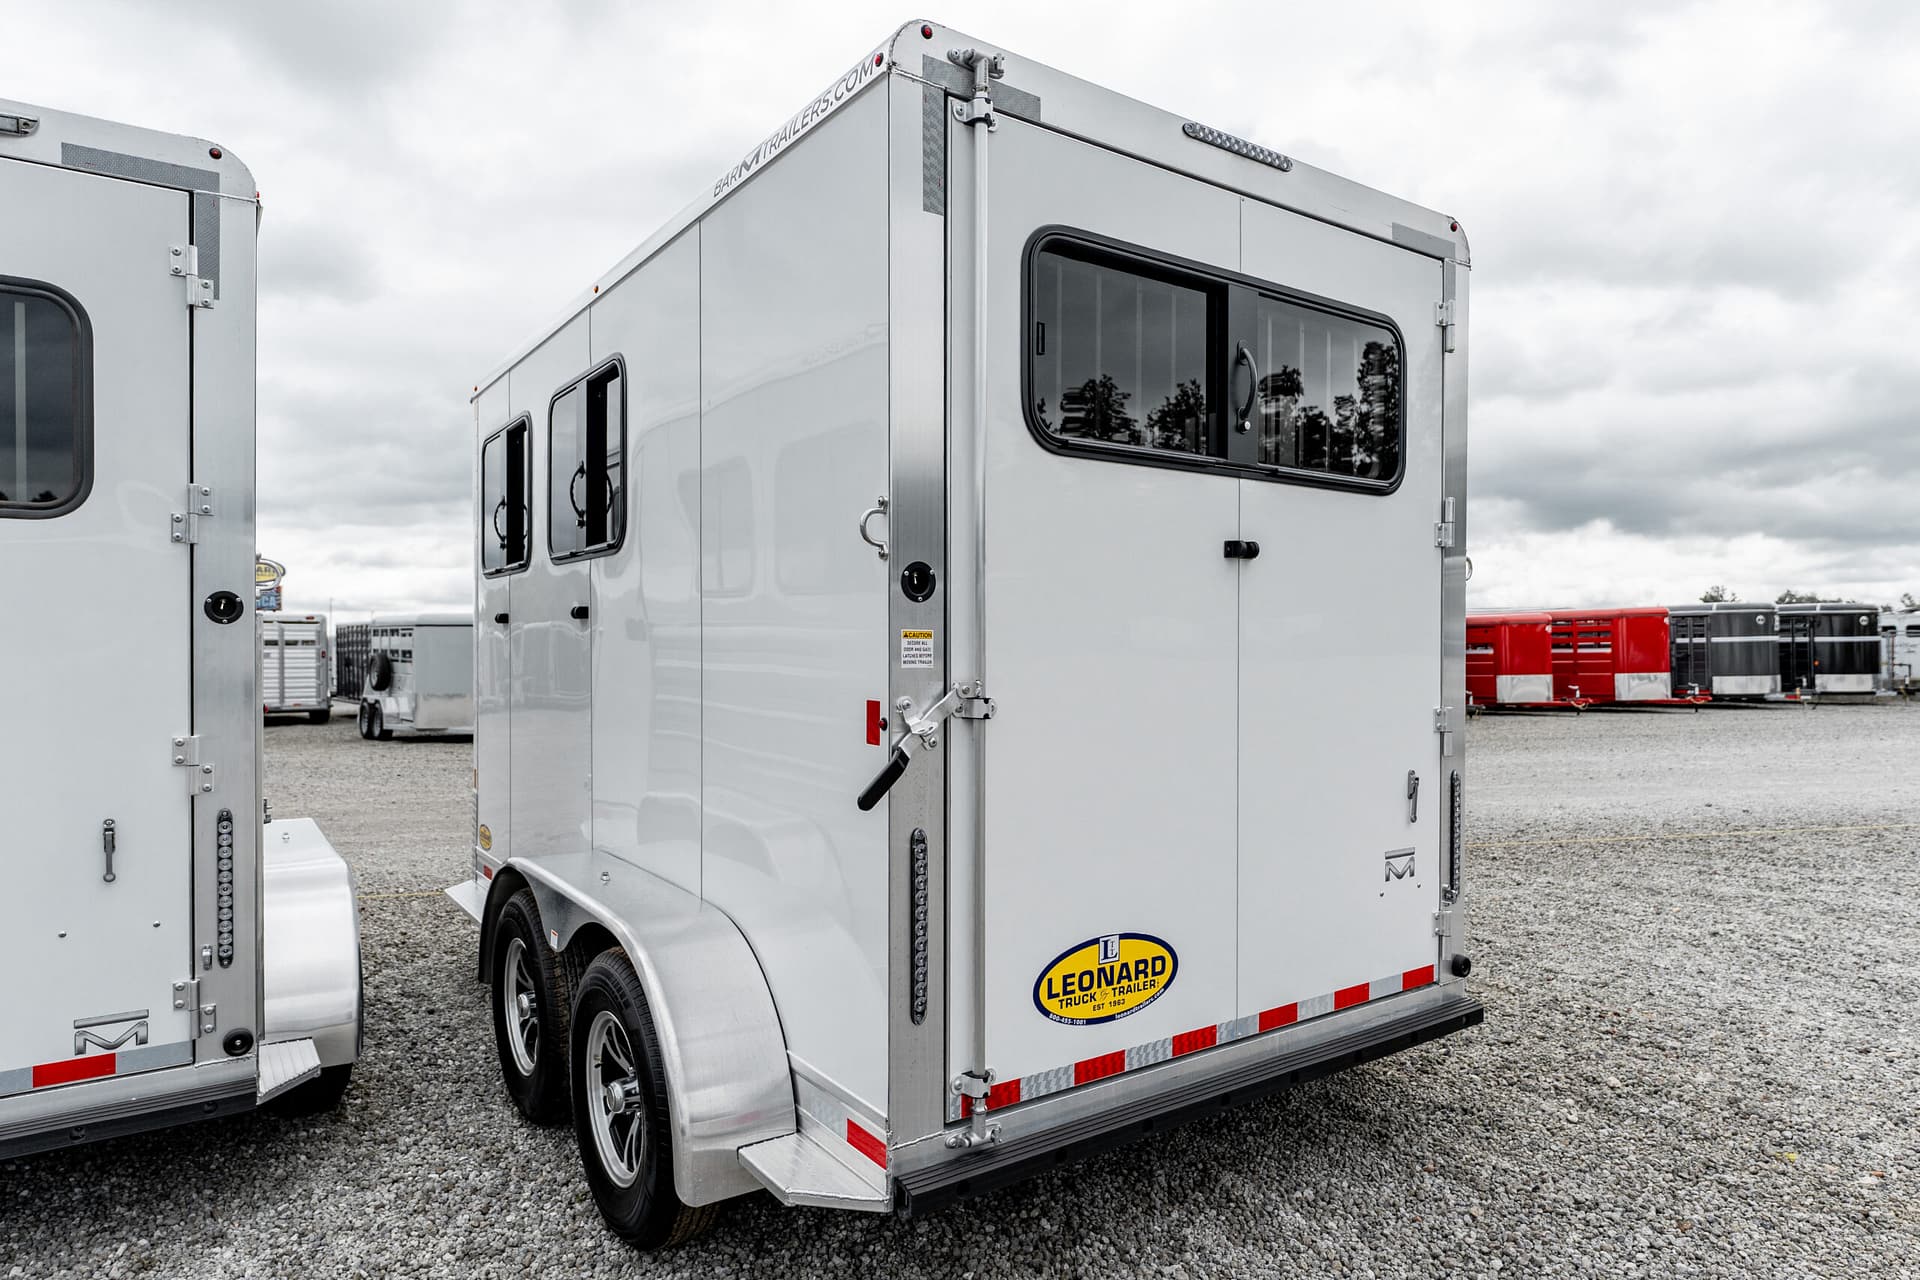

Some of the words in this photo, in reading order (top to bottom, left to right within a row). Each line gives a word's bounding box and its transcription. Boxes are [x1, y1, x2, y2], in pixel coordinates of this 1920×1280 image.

[1047, 955, 1166, 1000] LEONARD
[1058, 991, 1097, 1009] TRUCK
[1111, 979, 1156, 998] TRAILER
[1092, 1002, 1105, 1012] EST
[1109, 998, 1125, 1008] 1963
